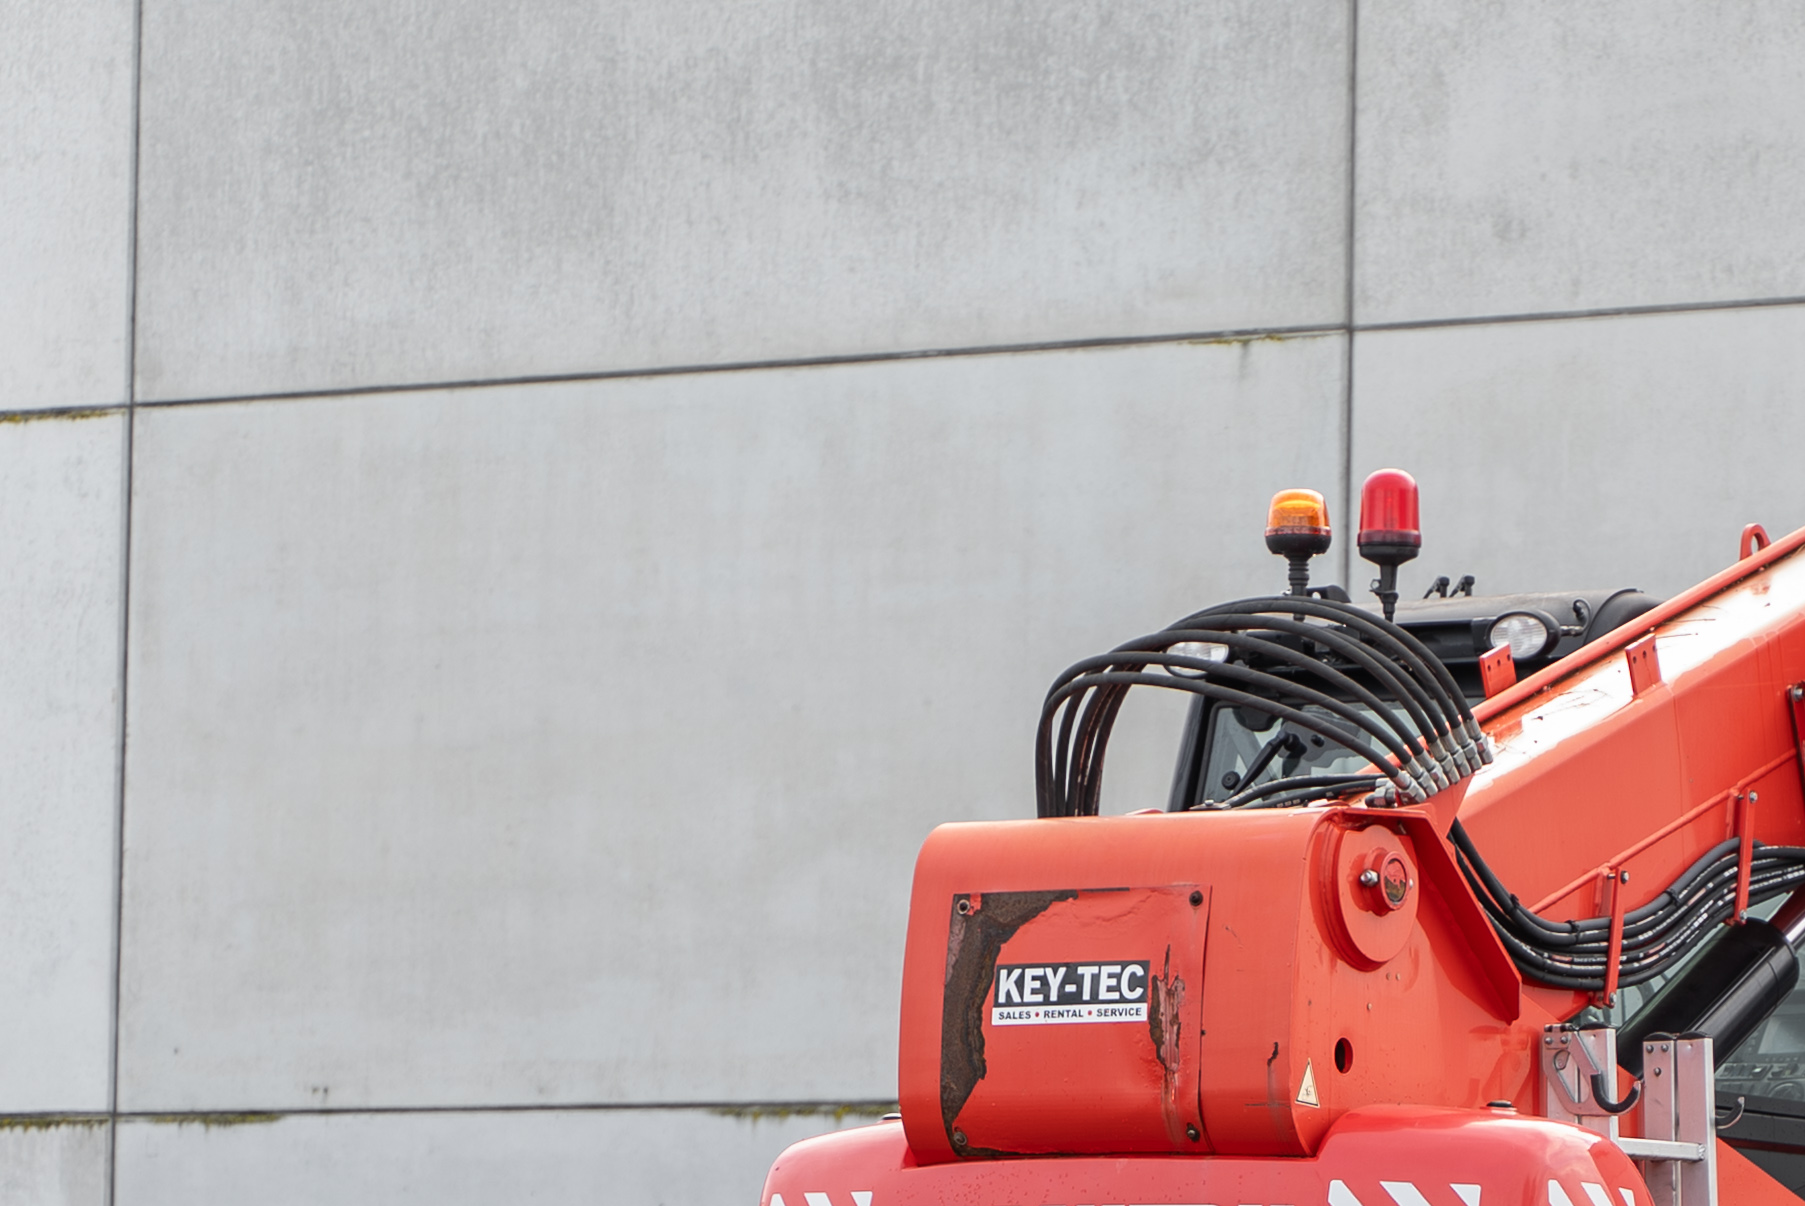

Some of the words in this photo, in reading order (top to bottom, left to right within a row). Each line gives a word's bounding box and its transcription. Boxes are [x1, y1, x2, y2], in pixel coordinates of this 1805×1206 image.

[998, 963, 1145, 1004] KEY-TEC
[998, 1010, 1032, 1020] SALES
[1043, 1009, 1084, 1019] RENTAL
[1096, 1007, 1142, 1017] SERVICE
